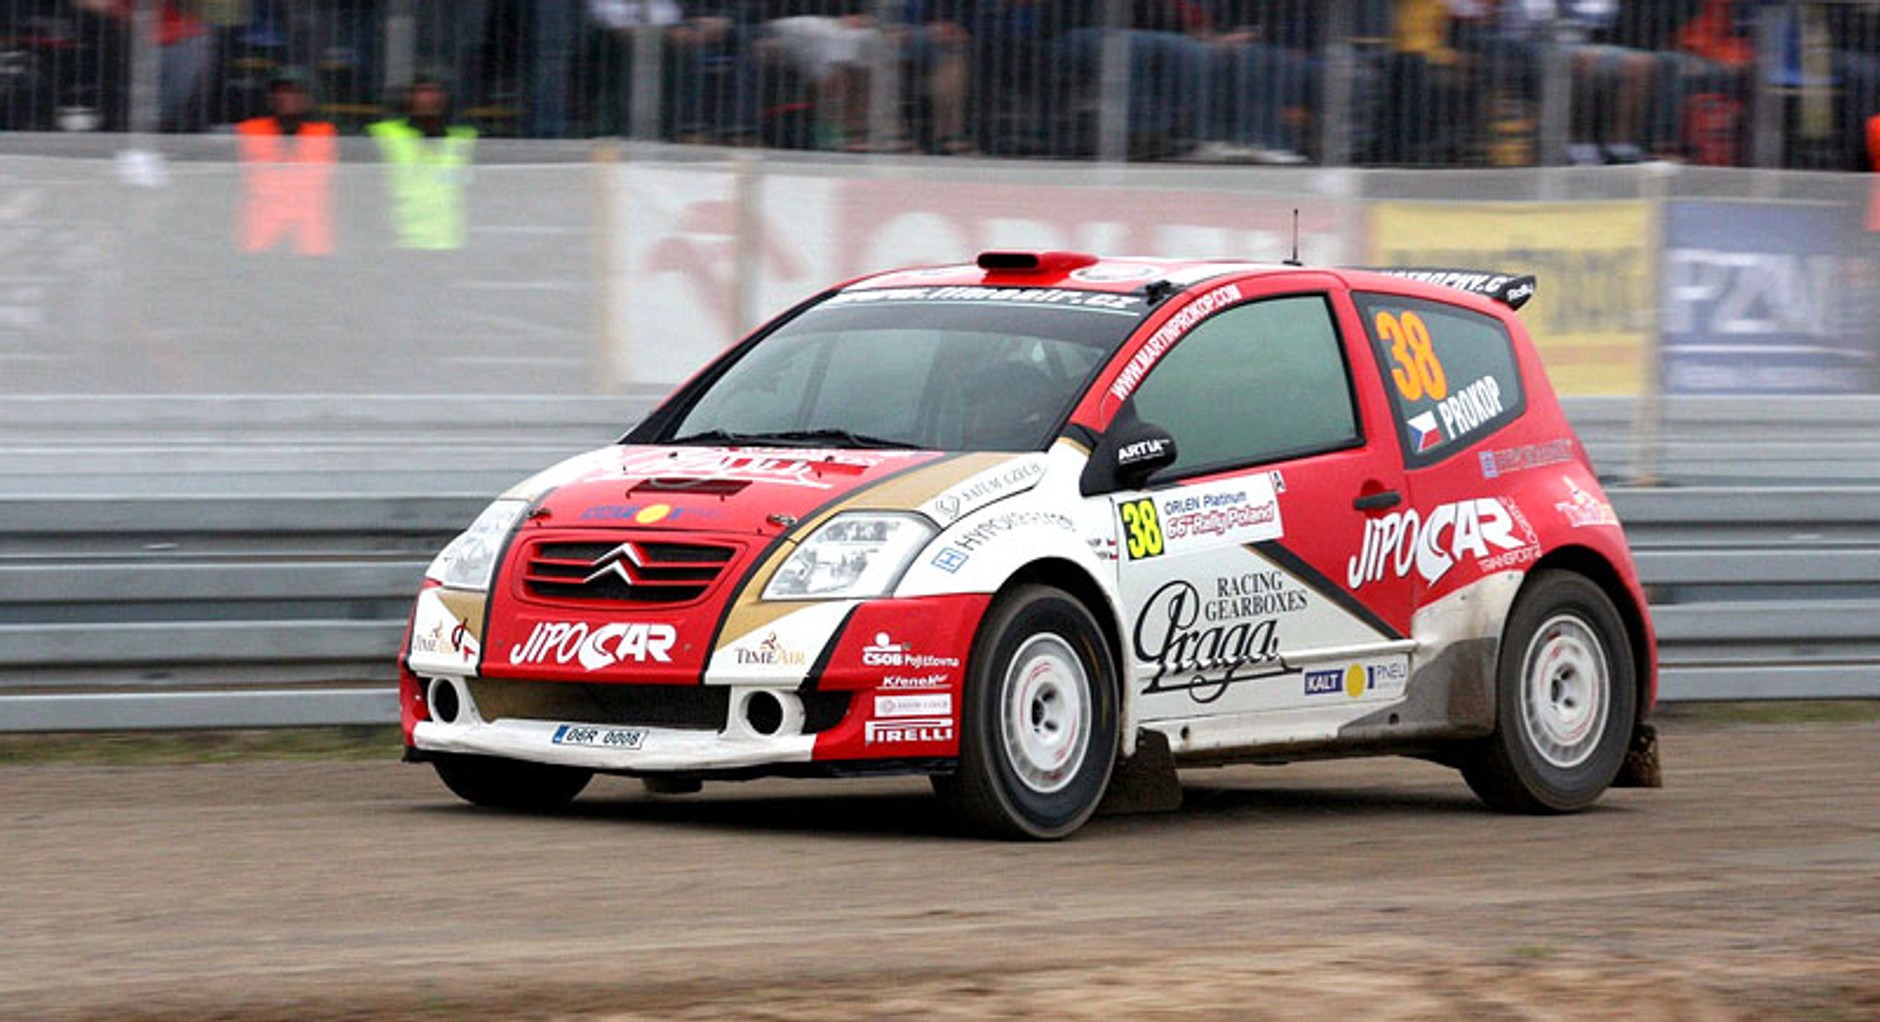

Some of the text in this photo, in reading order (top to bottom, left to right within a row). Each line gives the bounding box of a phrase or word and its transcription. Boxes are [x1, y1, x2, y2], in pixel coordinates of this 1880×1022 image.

[1109, 284, 1242, 401] WWW.MARTINPROKOP.COM
[1375, 311, 1448, 402] 38
[1438, 375, 1502, 440] PROKOP
[1164, 491, 1247, 516] ORLEN Platinum
[1192, 509, 1225, 536] Rally
[1226, 500, 1274, 529] Poland
[1123, 499, 1163, 559] 38
[1347, 498, 1526, 589] JIPOCAR
[1216, 571, 1283, 598] RACING
[1204, 590, 1309, 623] GEARBOXES
[509, 622, 677, 671] JIPOCAR
[1306, 673, 1339, 692] KALT
[864, 717, 954, 747] PIRELLI
